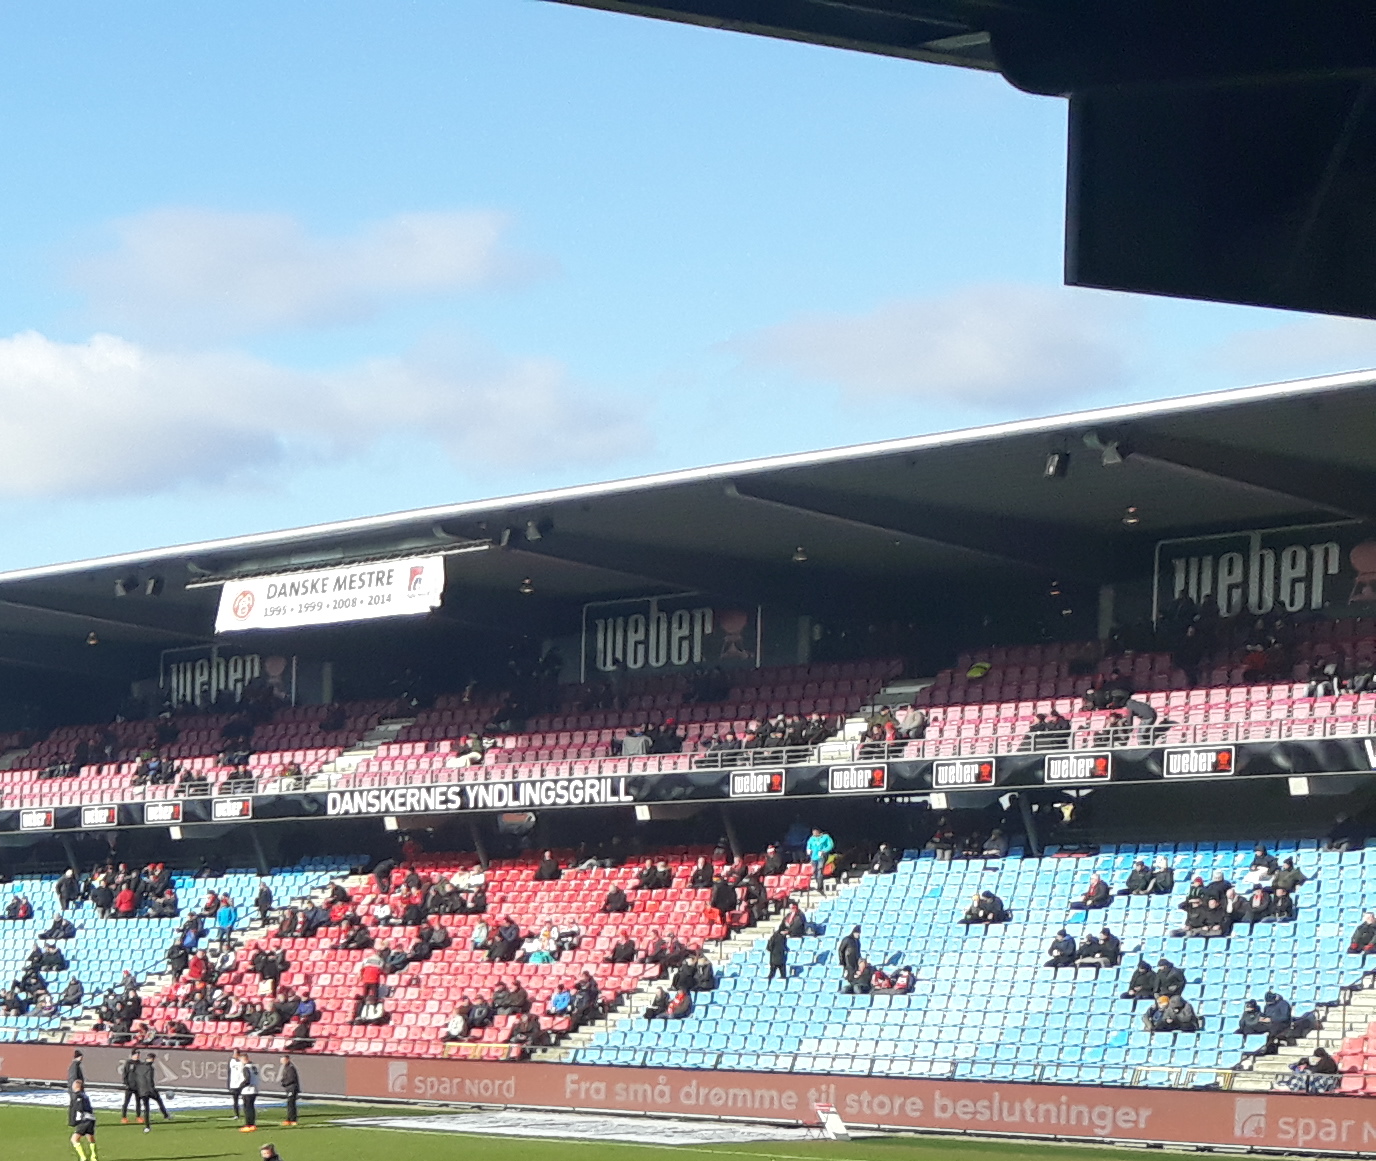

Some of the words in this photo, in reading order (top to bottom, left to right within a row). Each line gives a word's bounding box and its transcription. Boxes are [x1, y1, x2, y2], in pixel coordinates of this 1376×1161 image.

[266, 577, 329, 600] DANSKE
[333, 568, 395, 592] MESTRE
[1172, 531, 1340, 618] weber
[368, 594, 392, 607] 2014
[595, 599, 714, 671] weber
[937, 762, 979, 785] weber
[1050, 756, 1095, 779] weber
[1169, 750, 1216, 774] weber
[734, 773, 771, 794] weber
[833, 768, 873, 790] weber
[327, 786, 461, 816] DANSKERNES
[465, 777, 634, 808] YNDLINGSGRILL
[414, 1076, 461, 1098] spar
[465, 1075, 515, 1098] Nord
[565, 1073, 606, 1099] Fra
[614, 1075, 671, 1104] små
[679, 1079, 797, 1110] drømme
[810, 1083, 836, 1108] til
[845, 1088, 923, 1118] store
[933, 1085, 1152, 1135] beslutninger
[1277, 1117, 1356, 1147] spar
